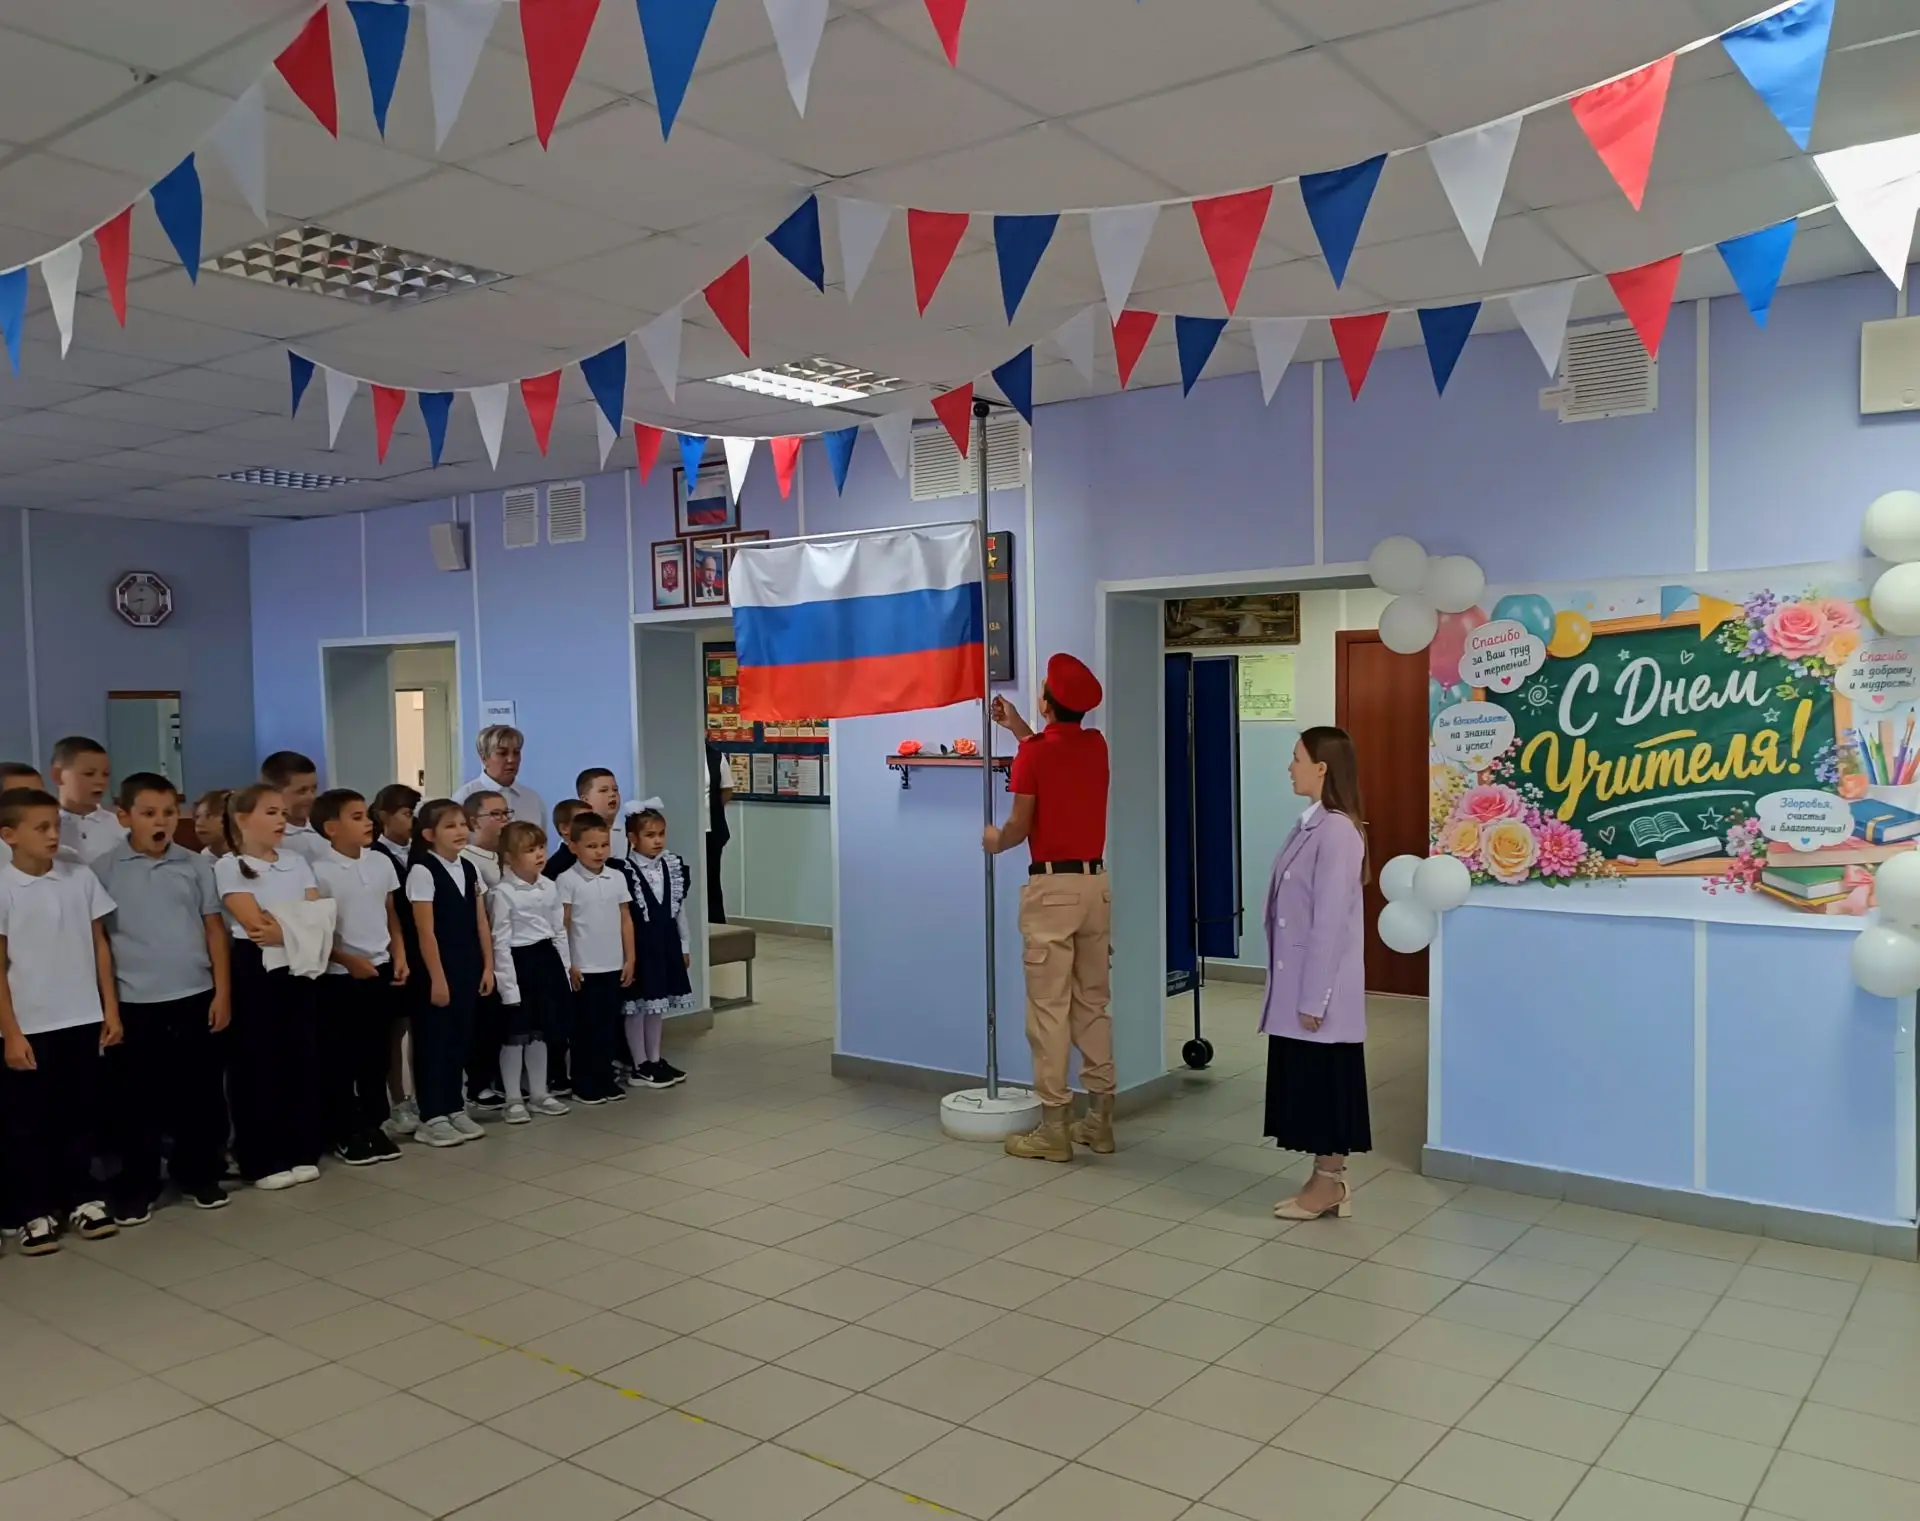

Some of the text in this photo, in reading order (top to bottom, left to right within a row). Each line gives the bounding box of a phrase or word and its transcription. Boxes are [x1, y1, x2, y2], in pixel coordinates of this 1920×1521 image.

[1472, 628, 1520, 650] Спасибо
[1472, 644, 1531, 666] за Ваш труд
[1859, 650, 1908, 662] Спасибо
[1475, 655, 1531, 679] и терпение!
[1852, 668, 1864, 677] за
[1849, 682, 1855, 690] и
[1558, 656, 1772, 737] С Днем
[1450, 729, 1496, 739] на знания
[1456, 740, 1493, 754] и успех!
[1520, 699, 1813, 822] Учителя!
[1787, 813, 1826, 821] счастья
